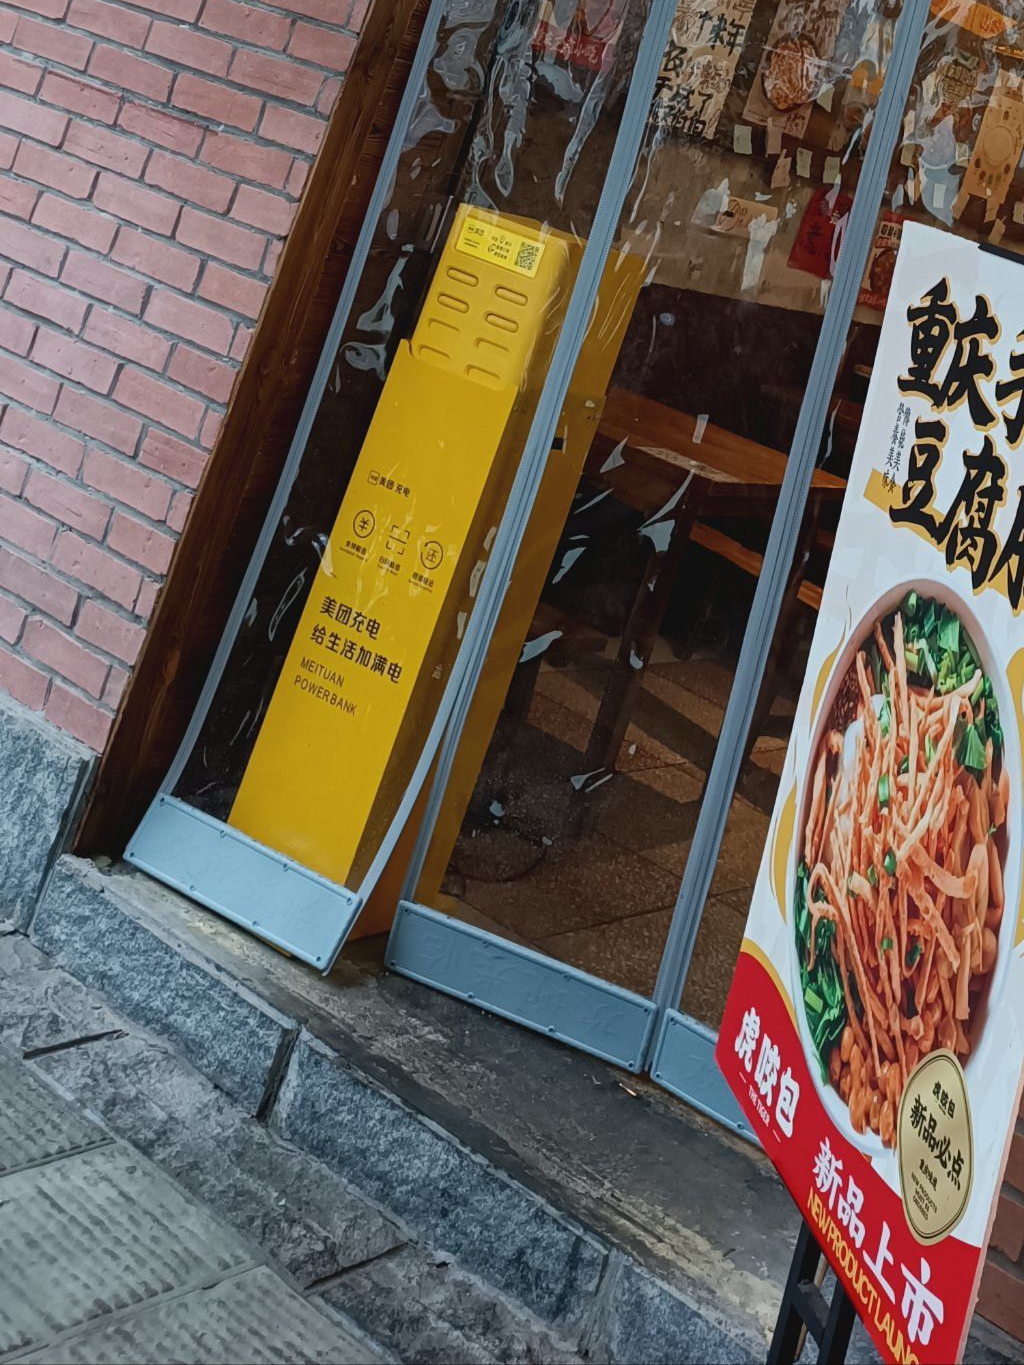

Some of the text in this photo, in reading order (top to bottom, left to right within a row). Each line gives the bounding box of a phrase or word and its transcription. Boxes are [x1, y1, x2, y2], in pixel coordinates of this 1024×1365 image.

[320, 596, 381, 640] 美团充电
[300, 656, 345, 688] MEITUAN
[310, 623, 402, 684] 给生活加满电
[293, 674, 358, 716] POWERBANK
[748, 1084, 770, 1127] THE TIGER
[910, 1093, 965, 1192] 新品必点
[807, 1186, 831, 1235] NEW
[826, 1224, 878, 1315] PRODUCT
[812, 1136, 944, 1345] 新品上市
